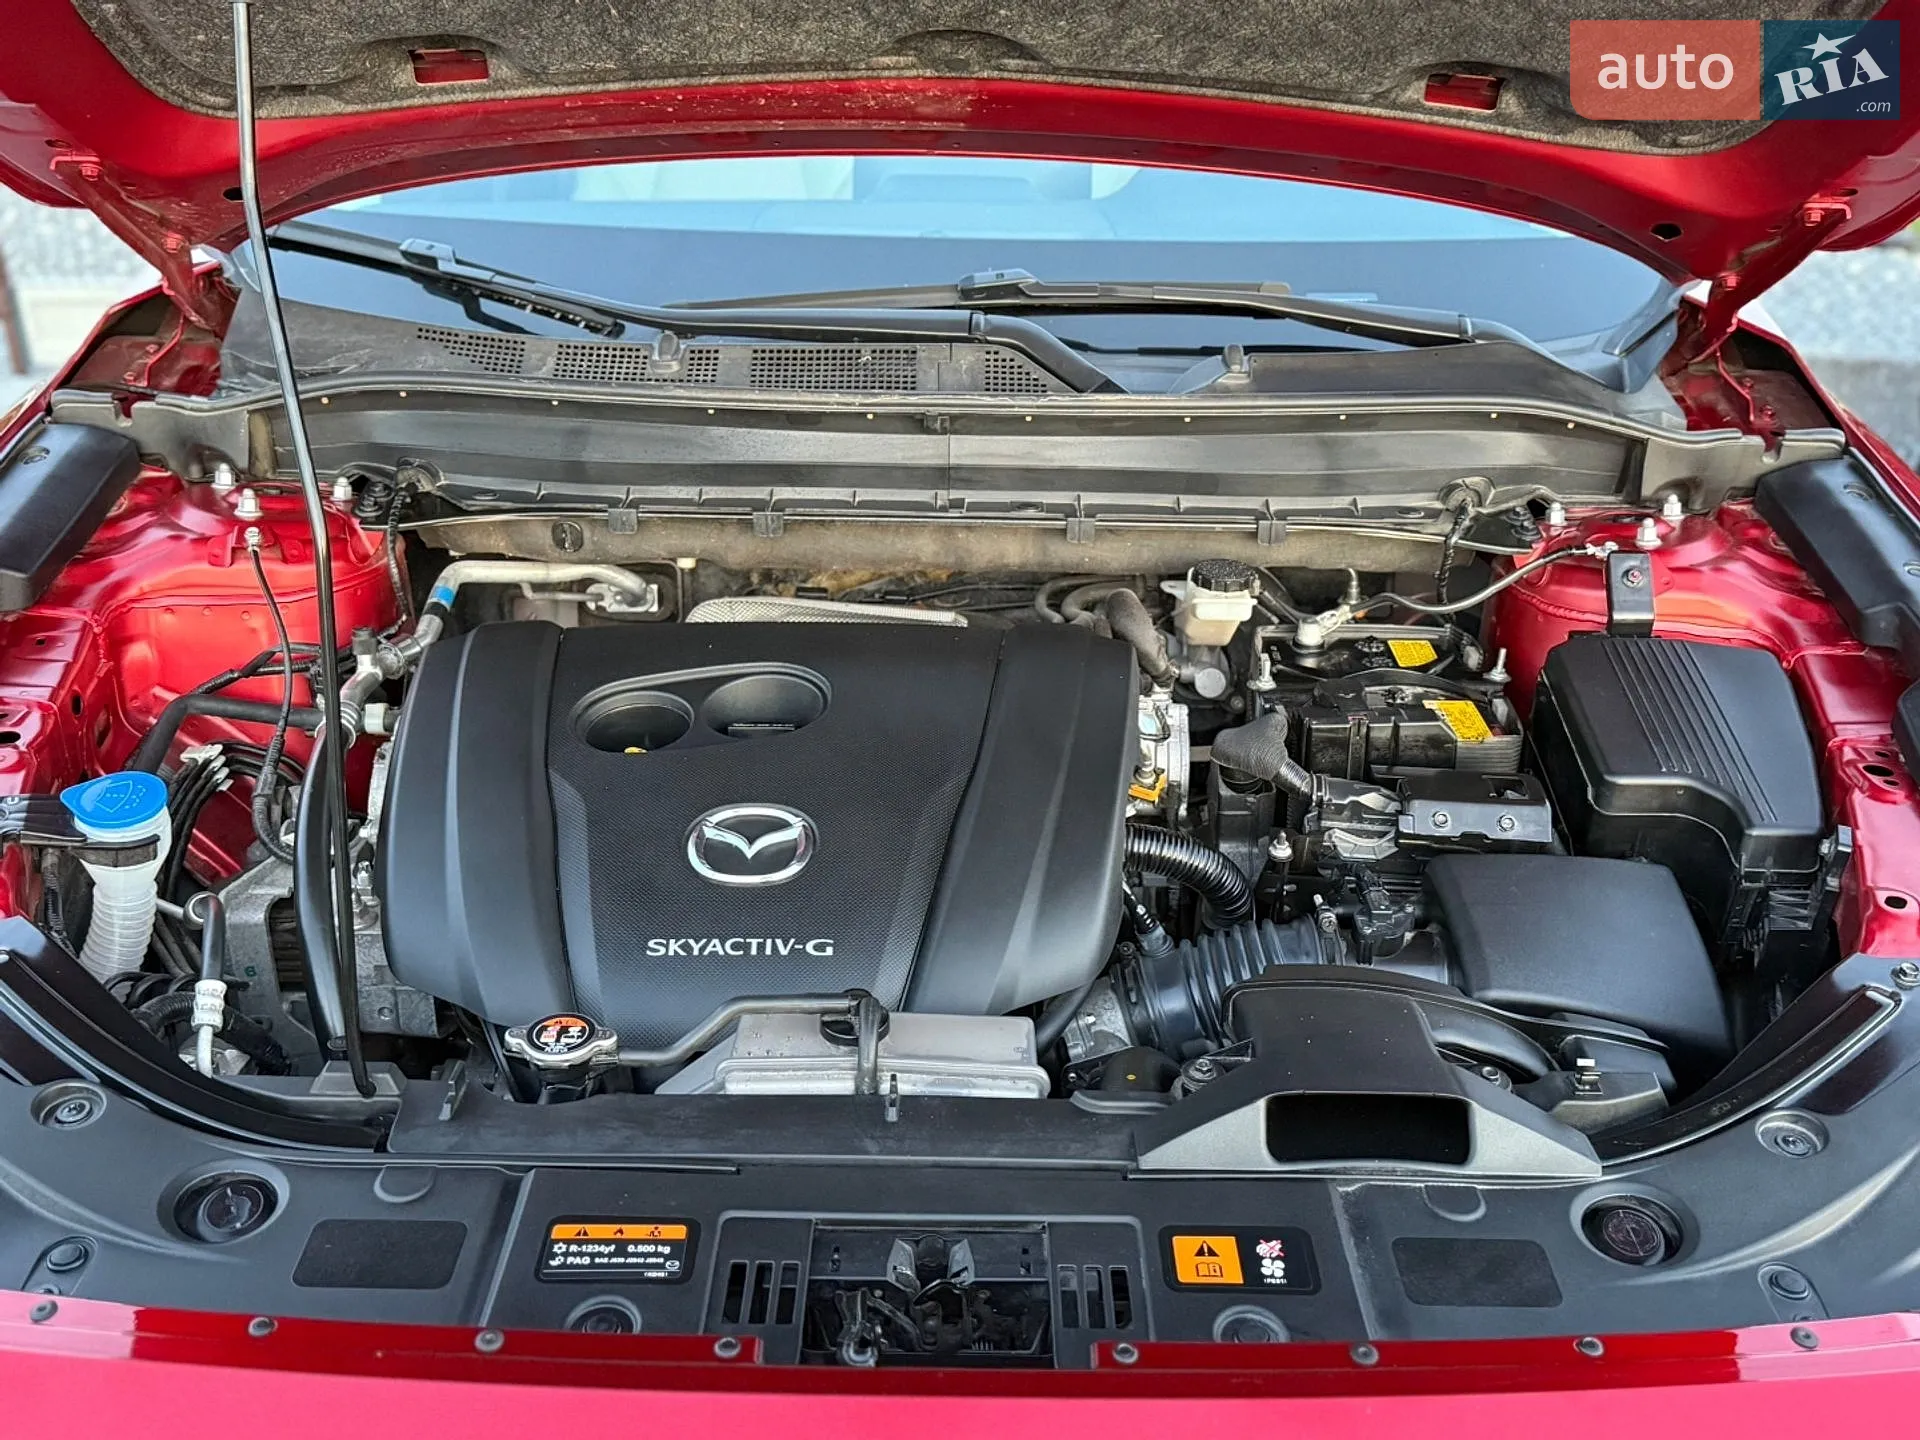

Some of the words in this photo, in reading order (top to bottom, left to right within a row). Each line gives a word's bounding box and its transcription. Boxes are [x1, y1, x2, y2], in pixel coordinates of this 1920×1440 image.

[646, 938, 834, 956] SKYACTIV-G
[569, 1244, 616, 1254] R-1234yf
[627, 1244, 655, 1253] 0.500
[657, 1244, 671, 1255] kg
[566, 1255, 591, 1265] PAG
